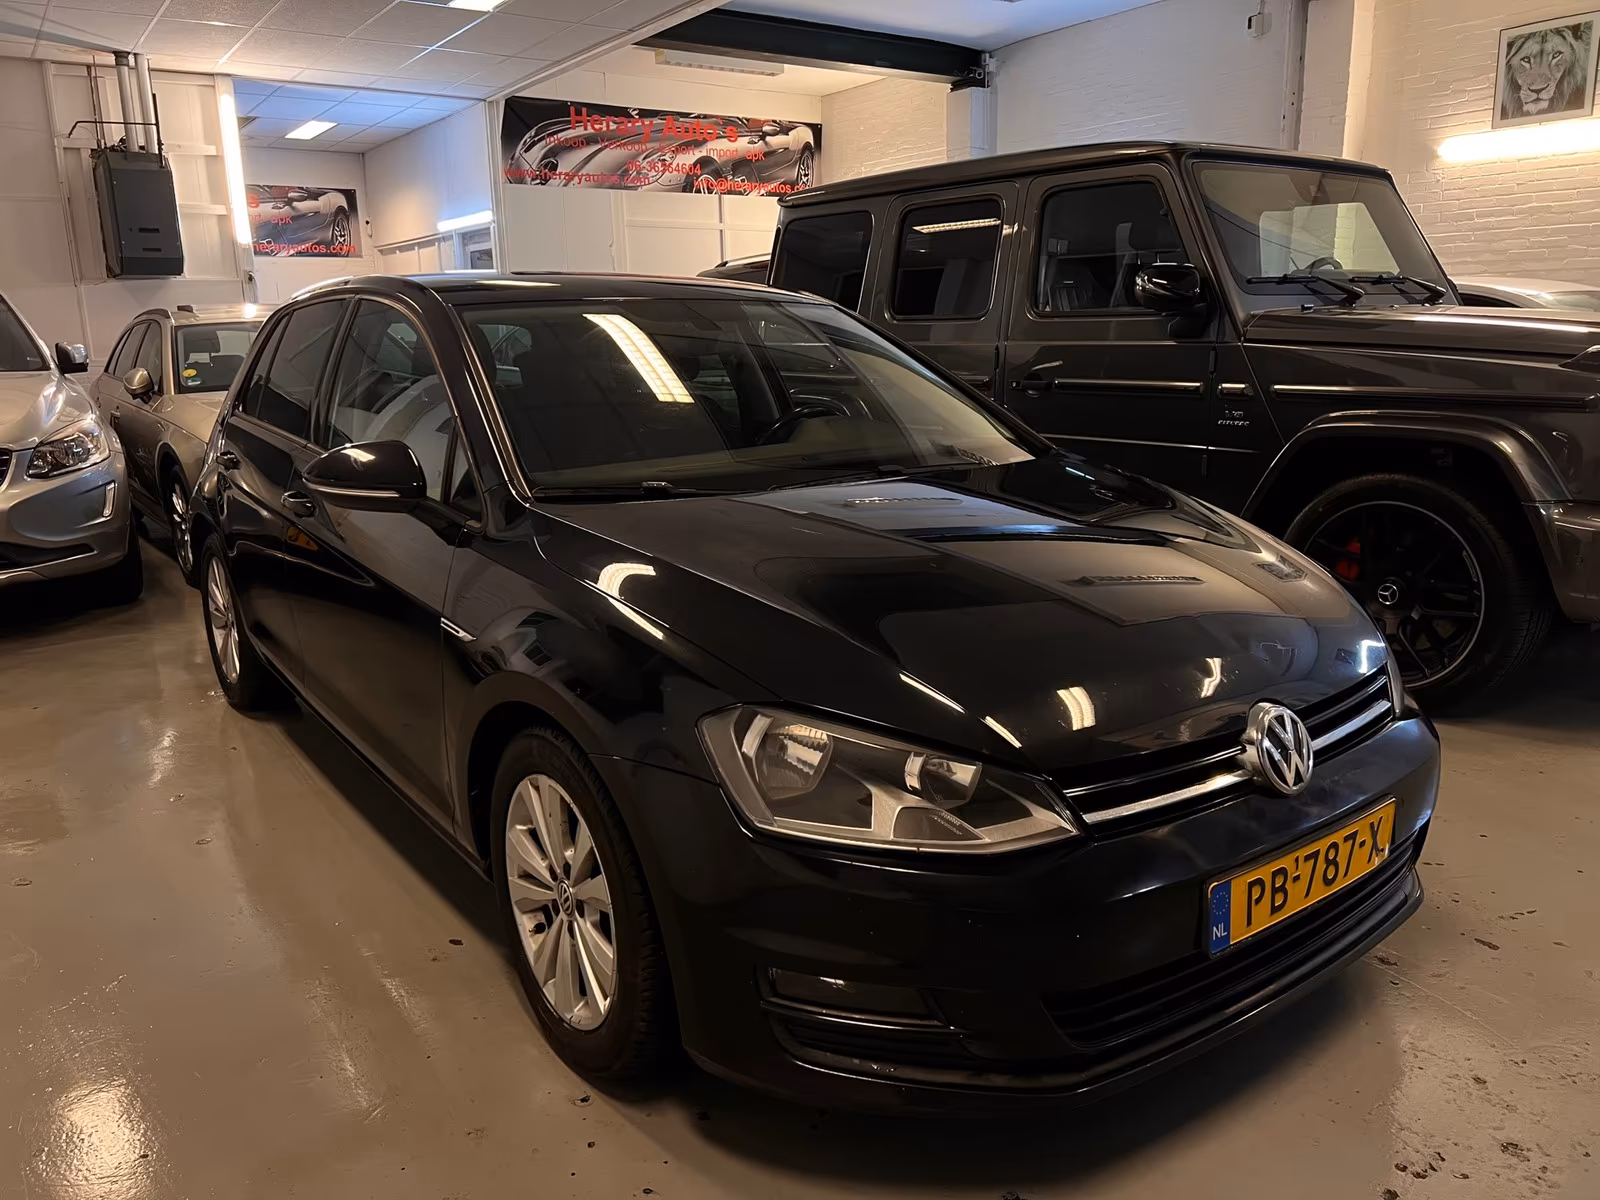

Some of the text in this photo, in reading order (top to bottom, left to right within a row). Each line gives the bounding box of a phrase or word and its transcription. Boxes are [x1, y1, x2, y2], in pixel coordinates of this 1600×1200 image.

[570, 106, 654, 142] Herary
[544, 134, 587, 149] Inkoop
[598, 137, 648, 155] Verkoop
[746, 150, 765, 162] apk
[271, 216, 292, 226] apk
[1246, 815, 1385, 928] PB-787-X
[1212, 921, 1228, 941] NL
